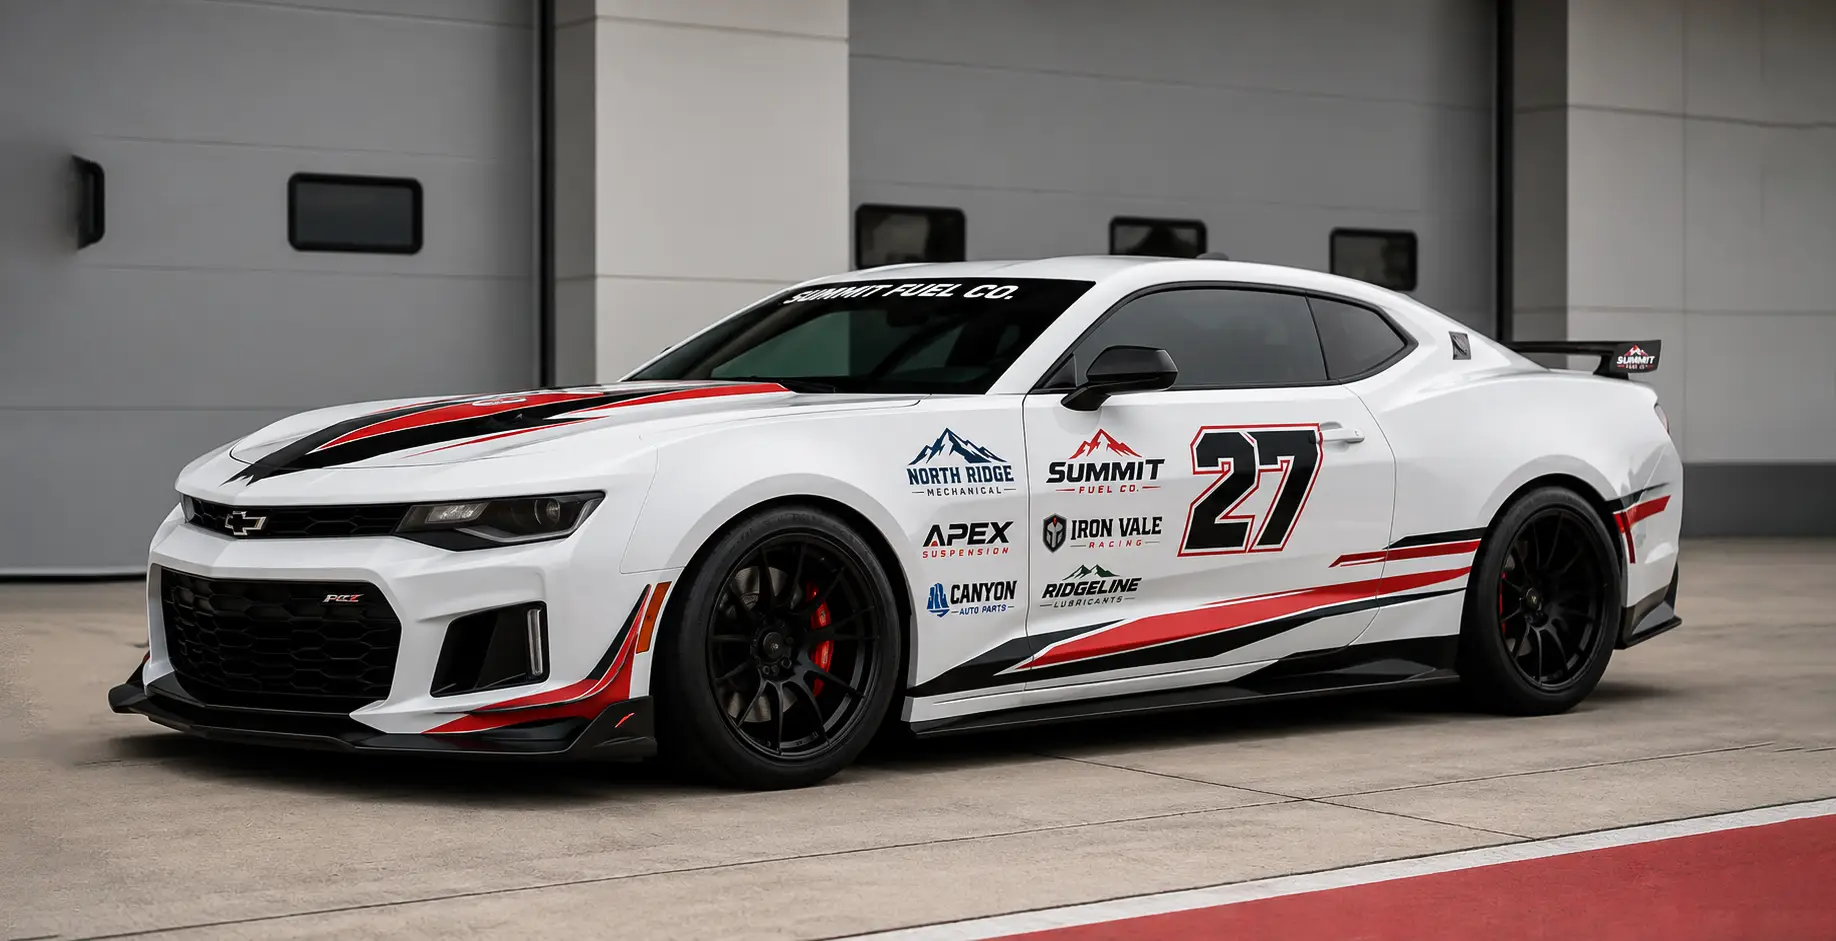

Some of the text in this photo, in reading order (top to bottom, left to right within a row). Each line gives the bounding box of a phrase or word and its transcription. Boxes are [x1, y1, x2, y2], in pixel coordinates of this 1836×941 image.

[783, 283, 1019, 304] SUMMIT FUEL CO.
[1617, 356, 1655, 364] SUMMIT
[908, 465, 1014, 485] NORTH RIDGE
[1046, 459, 1165, 483] SUMMIT
[927, 487, 1002, 497] MECHANICAL
[1079, 484, 1139, 494] FUEL CO.
[1177, 423, 1323, 557] 27
[922, 521, 1014, 547] APEX
[1071, 517, 1162, 540] IRON VALE
[922, 547, 1009, 558] SUSPENSION
[1089, 540, 1143, 549] RACING
[950, 581, 1017, 604] CANYON
[1042, 578, 1142, 598] RIDGELINE
[959, 605, 1007, 615] AUTO PARTS
[1054, 596, 1122, 607] LUBRICANTS
